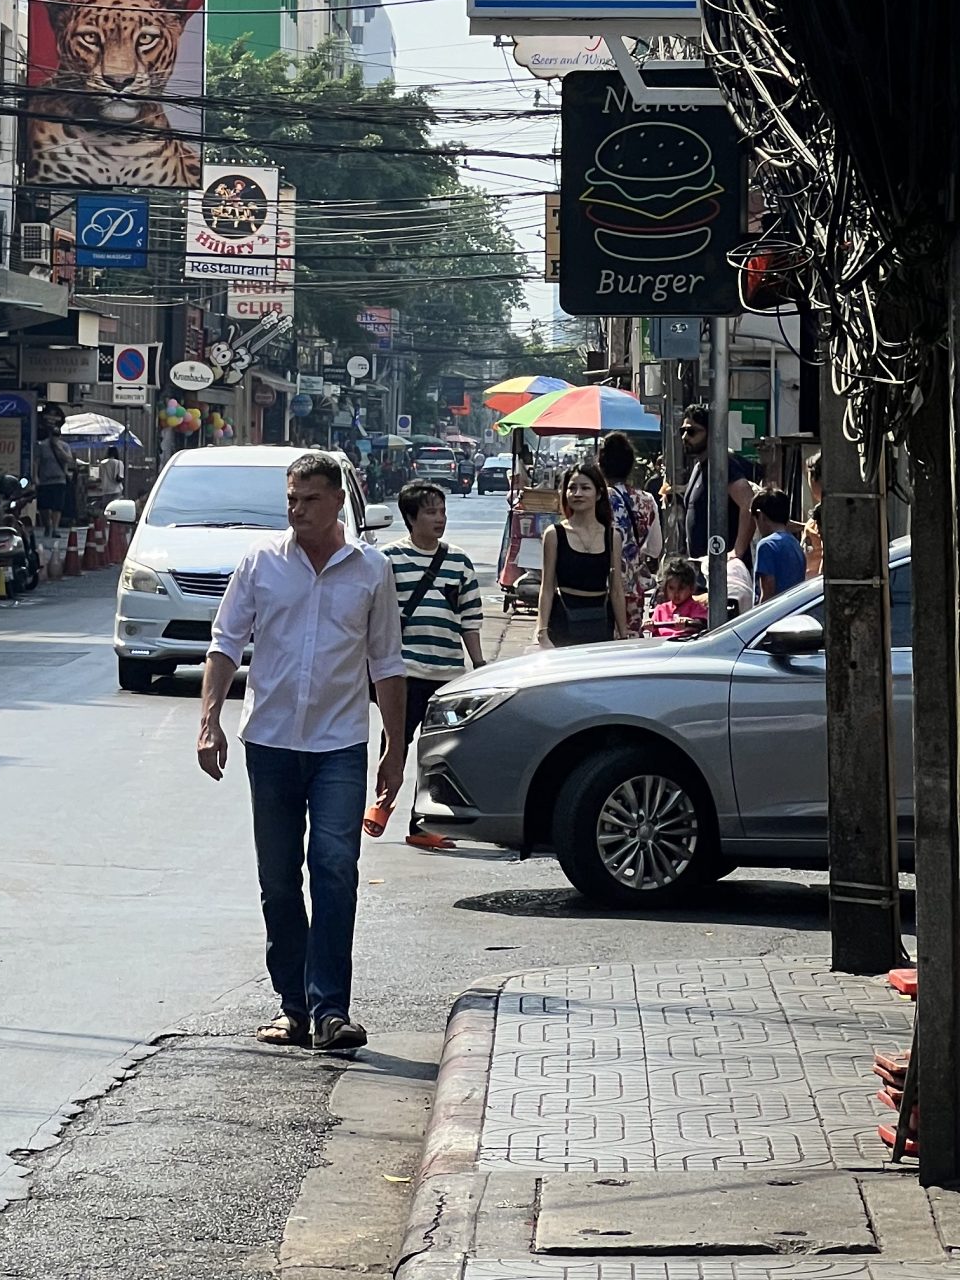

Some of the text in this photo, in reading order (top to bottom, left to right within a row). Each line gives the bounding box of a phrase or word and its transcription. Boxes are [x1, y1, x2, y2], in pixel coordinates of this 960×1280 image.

[531, 53, 558, 65] Beers
[560, 52, 581, 65] and
[191, 261, 269, 276] Restaurant
[596, 270, 706, 302] Burger
[237, 302, 283, 315] CLUB
